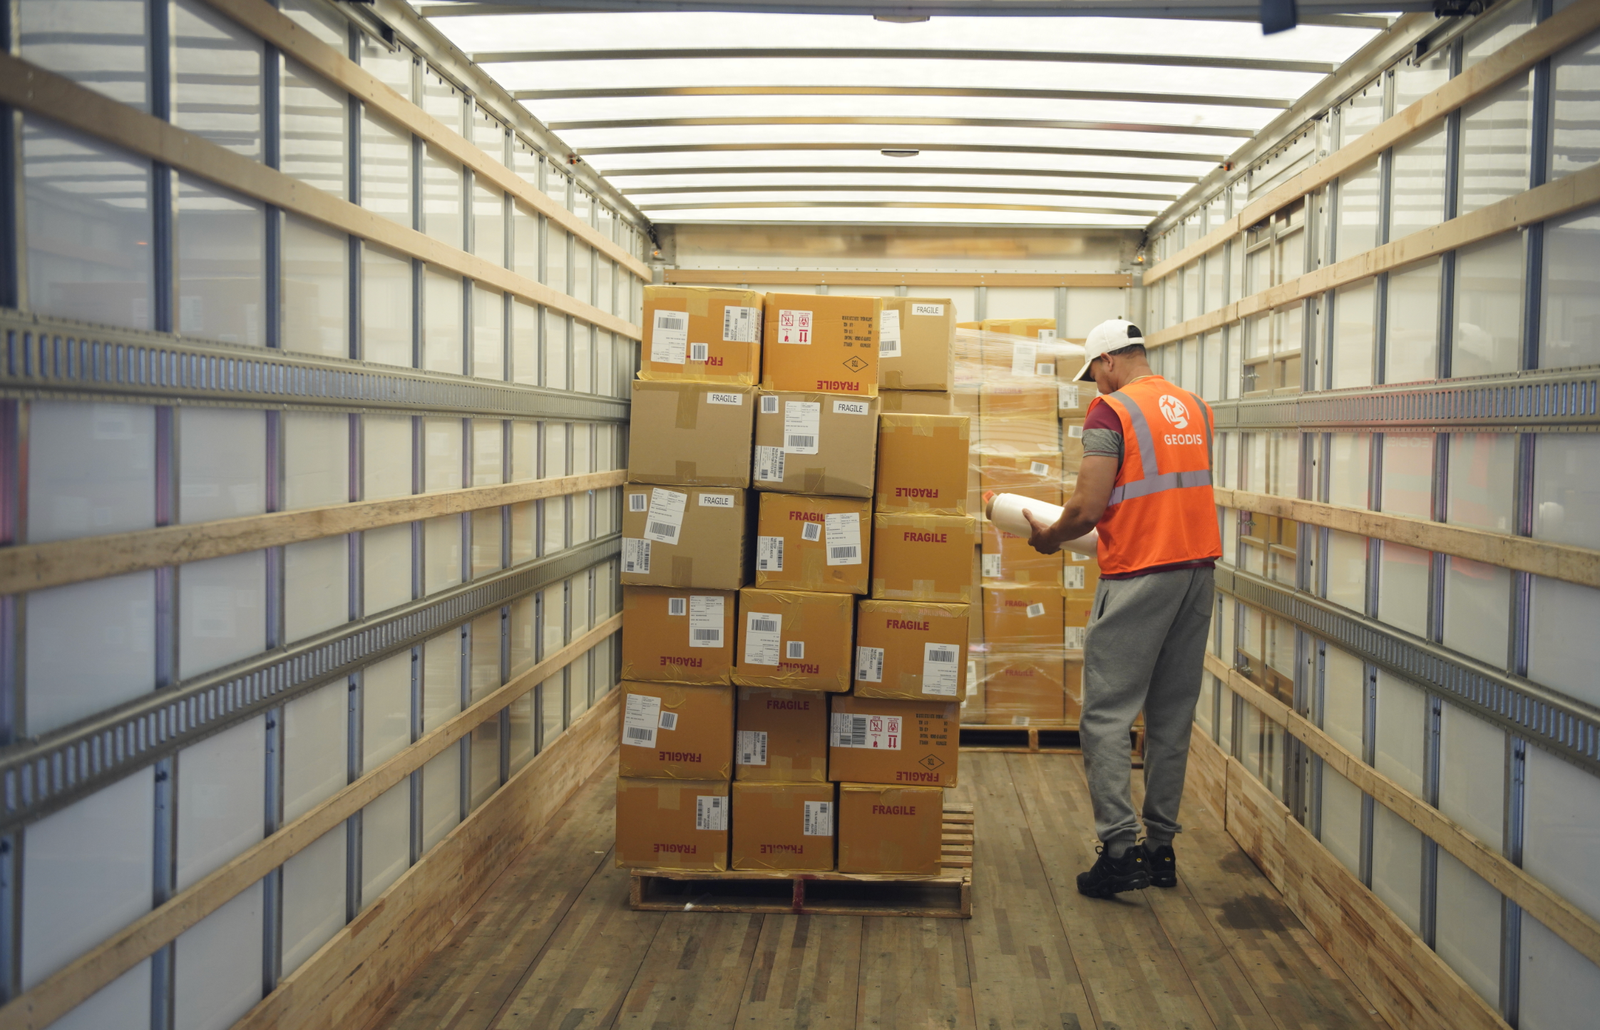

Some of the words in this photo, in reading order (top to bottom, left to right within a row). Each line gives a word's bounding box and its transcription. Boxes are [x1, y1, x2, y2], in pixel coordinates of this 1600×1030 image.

[916, 306, 939, 314] FRAGILE
[816, 380, 860, 390] FRAGILE
[712, 394, 737, 403] FRAGILE
[838, 403, 863, 413] FRAGILE
[1164, 434, 1203, 445] GEODIS
[896, 487, 938, 498] FRAGILE
[704, 496, 729, 506] FRAGILE
[789, 511, 829, 522] FRAGIL
[904, 531, 947, 543] FRAGILE
[886, 619, 930, 630] FRAGILE
[660, 656, 702, 668] FRAGILE
[777, 662, 819, 674] FRAGILE
[766, 700, 810, 711] FRAGILE
[659, 751, 702, 762] FRAGILE
[896, 771, 939, 782] FRAGILE
[872, 805, 916, 816] FRAGILE
[653, 844, 696, 854] FRAGILE
[760, 844, 803, 854] FRAGILE
